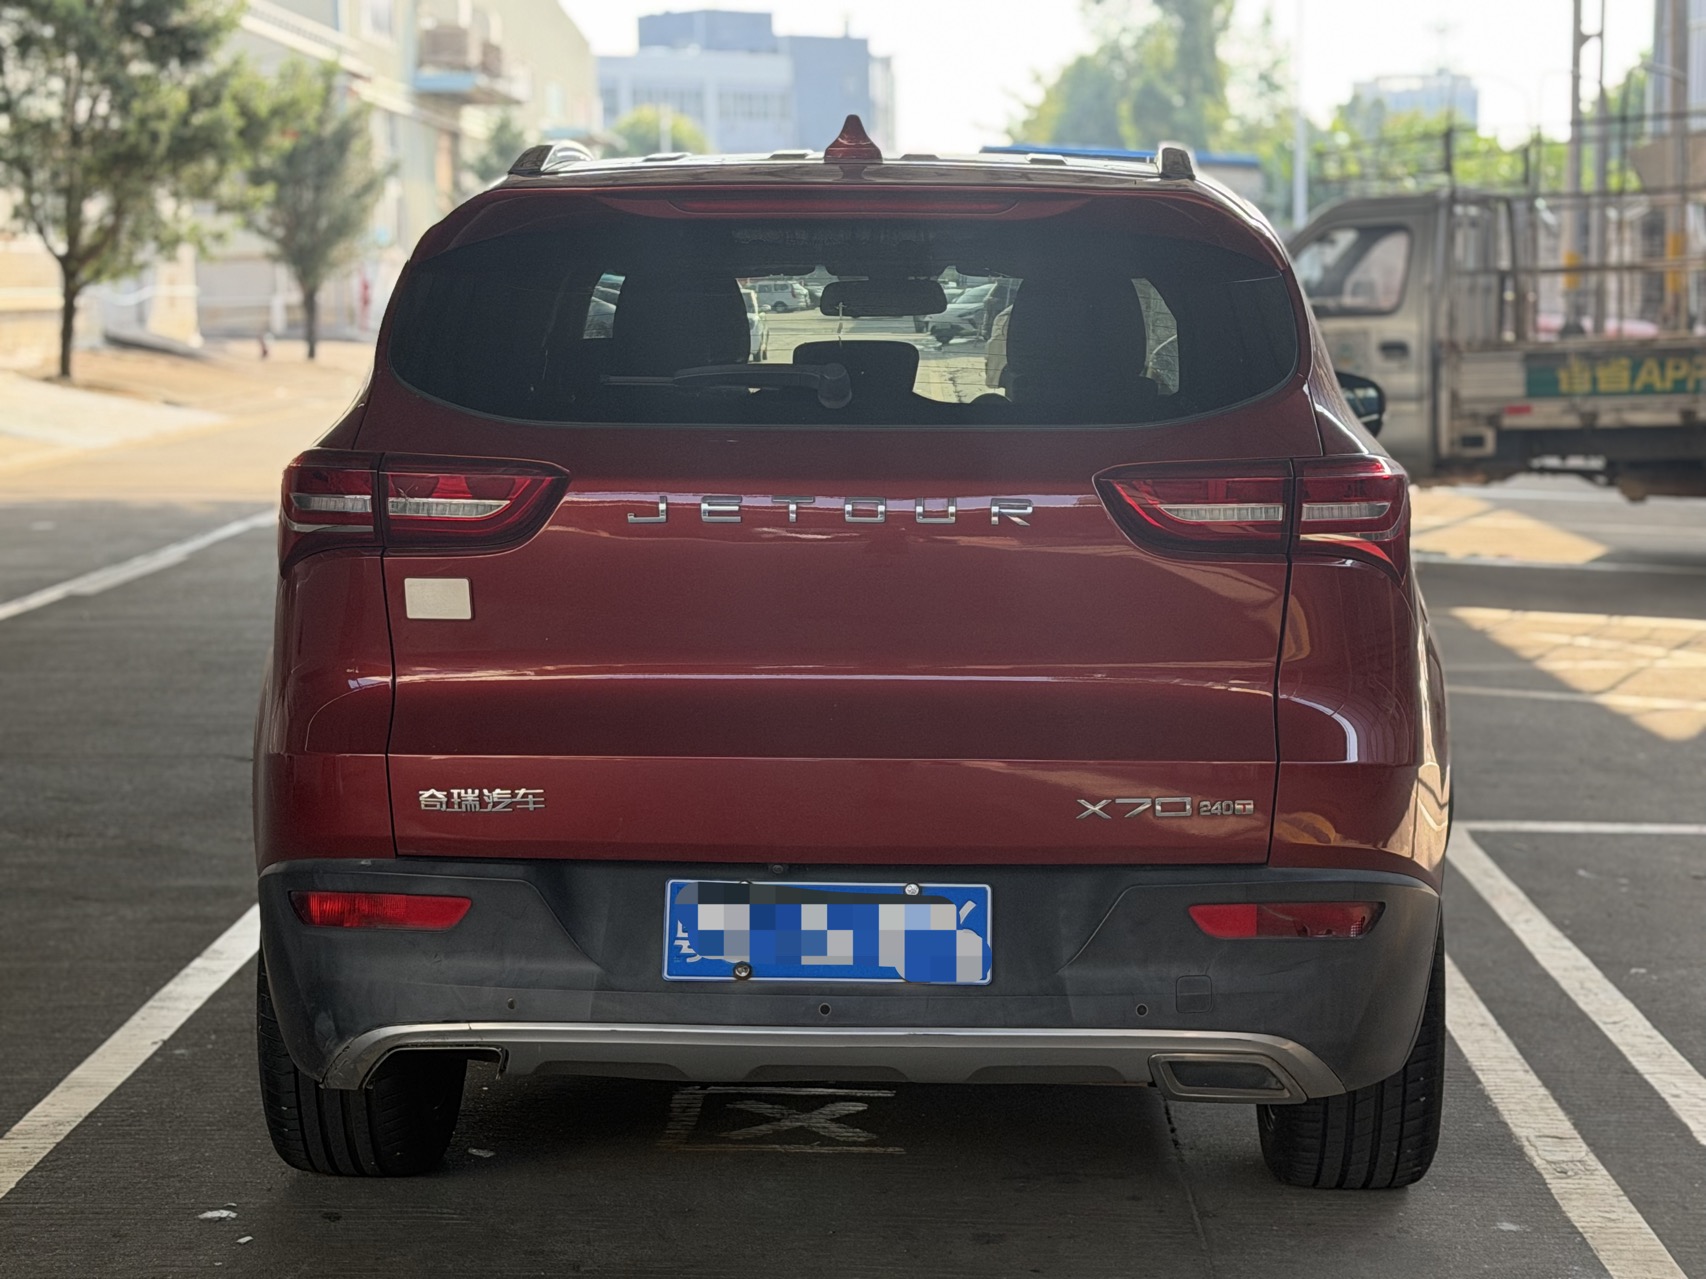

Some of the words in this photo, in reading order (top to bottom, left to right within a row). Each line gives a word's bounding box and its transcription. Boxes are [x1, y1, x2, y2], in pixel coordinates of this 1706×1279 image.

[628, 495, 1034, 526] JETOUR
[418, 788, 545, 812] 奇瑞汽车
[1075, 797, 1192, 819] X70
[1199, 799, 1254, 816] 240T
